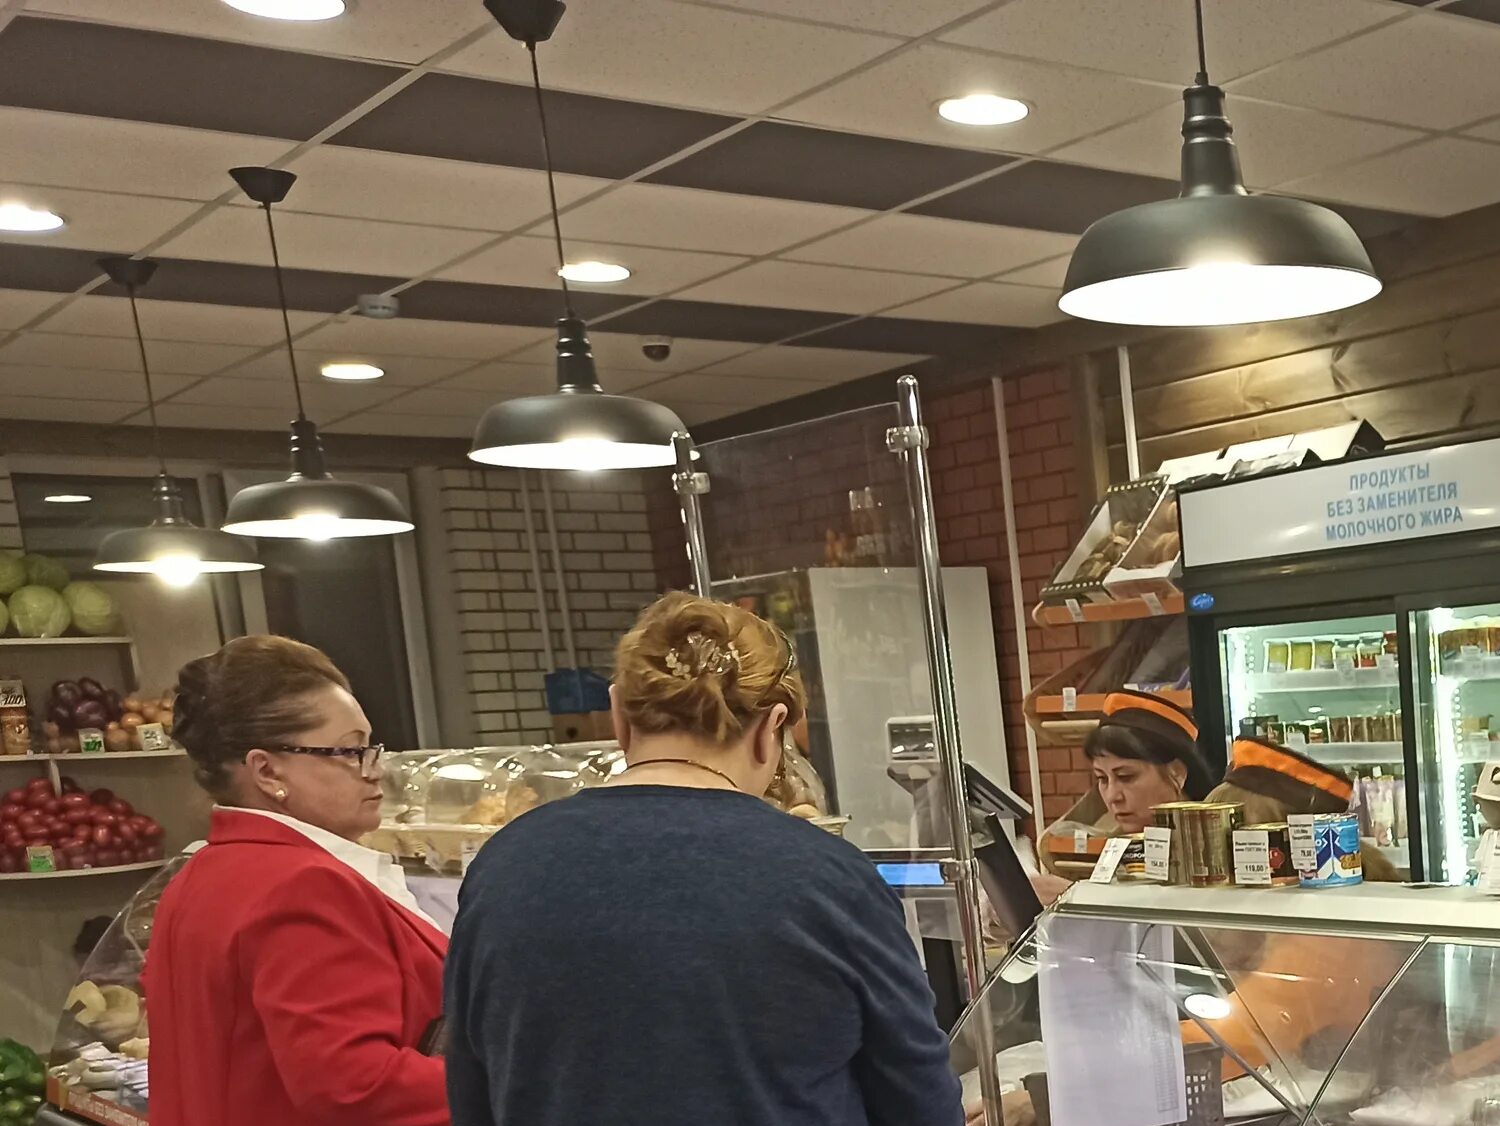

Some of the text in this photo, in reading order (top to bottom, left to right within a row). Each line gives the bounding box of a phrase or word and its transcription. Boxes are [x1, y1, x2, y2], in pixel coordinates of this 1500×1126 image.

[1350, 463, 1430, 491] ПРОДУКТЫ
[1327, 481, 1458, 518] БЕЗ ЗАМЕНИТЕЛЯ
[1326, 506, 1463, 541] МОЛОЧНОГО ЖИРА
